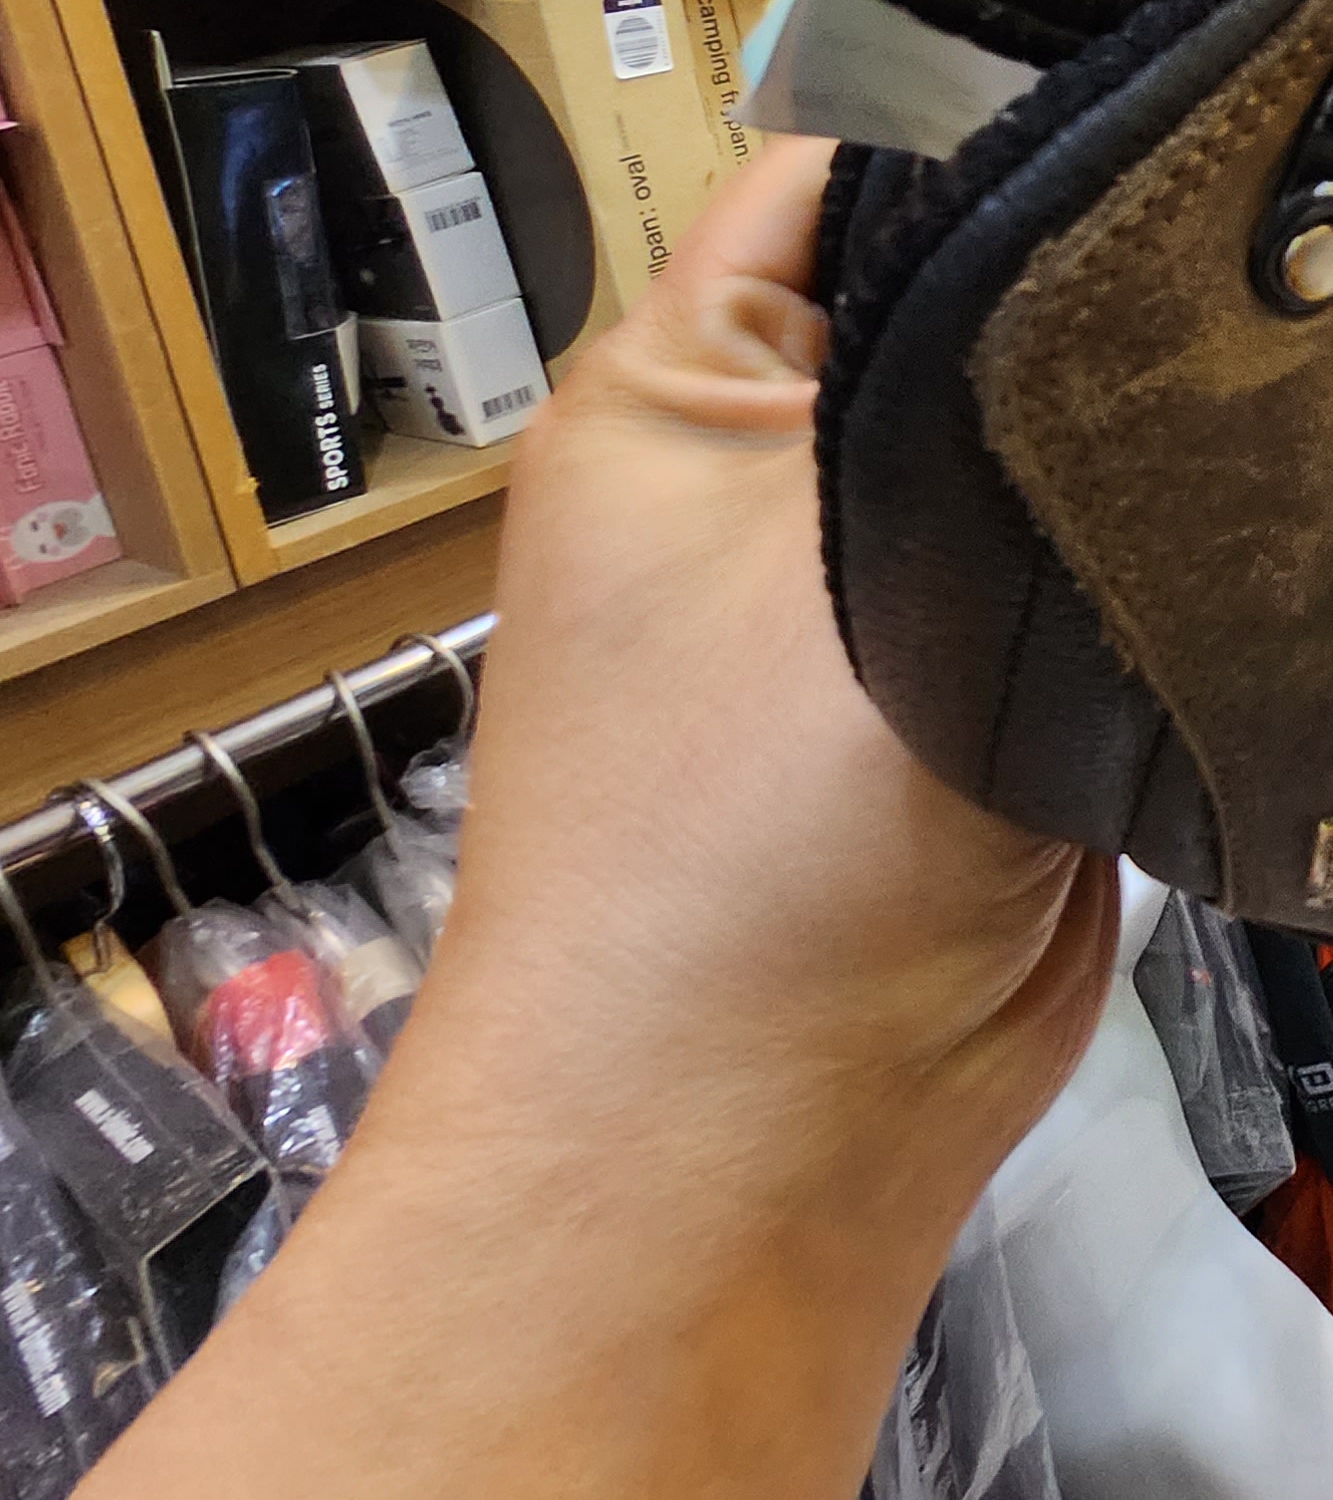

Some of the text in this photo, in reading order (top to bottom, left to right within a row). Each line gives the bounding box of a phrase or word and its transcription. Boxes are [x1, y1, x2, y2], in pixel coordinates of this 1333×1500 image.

[618, 153, 652, 202] oval
[311, 363, 350, 492] SPORTS SERIES
